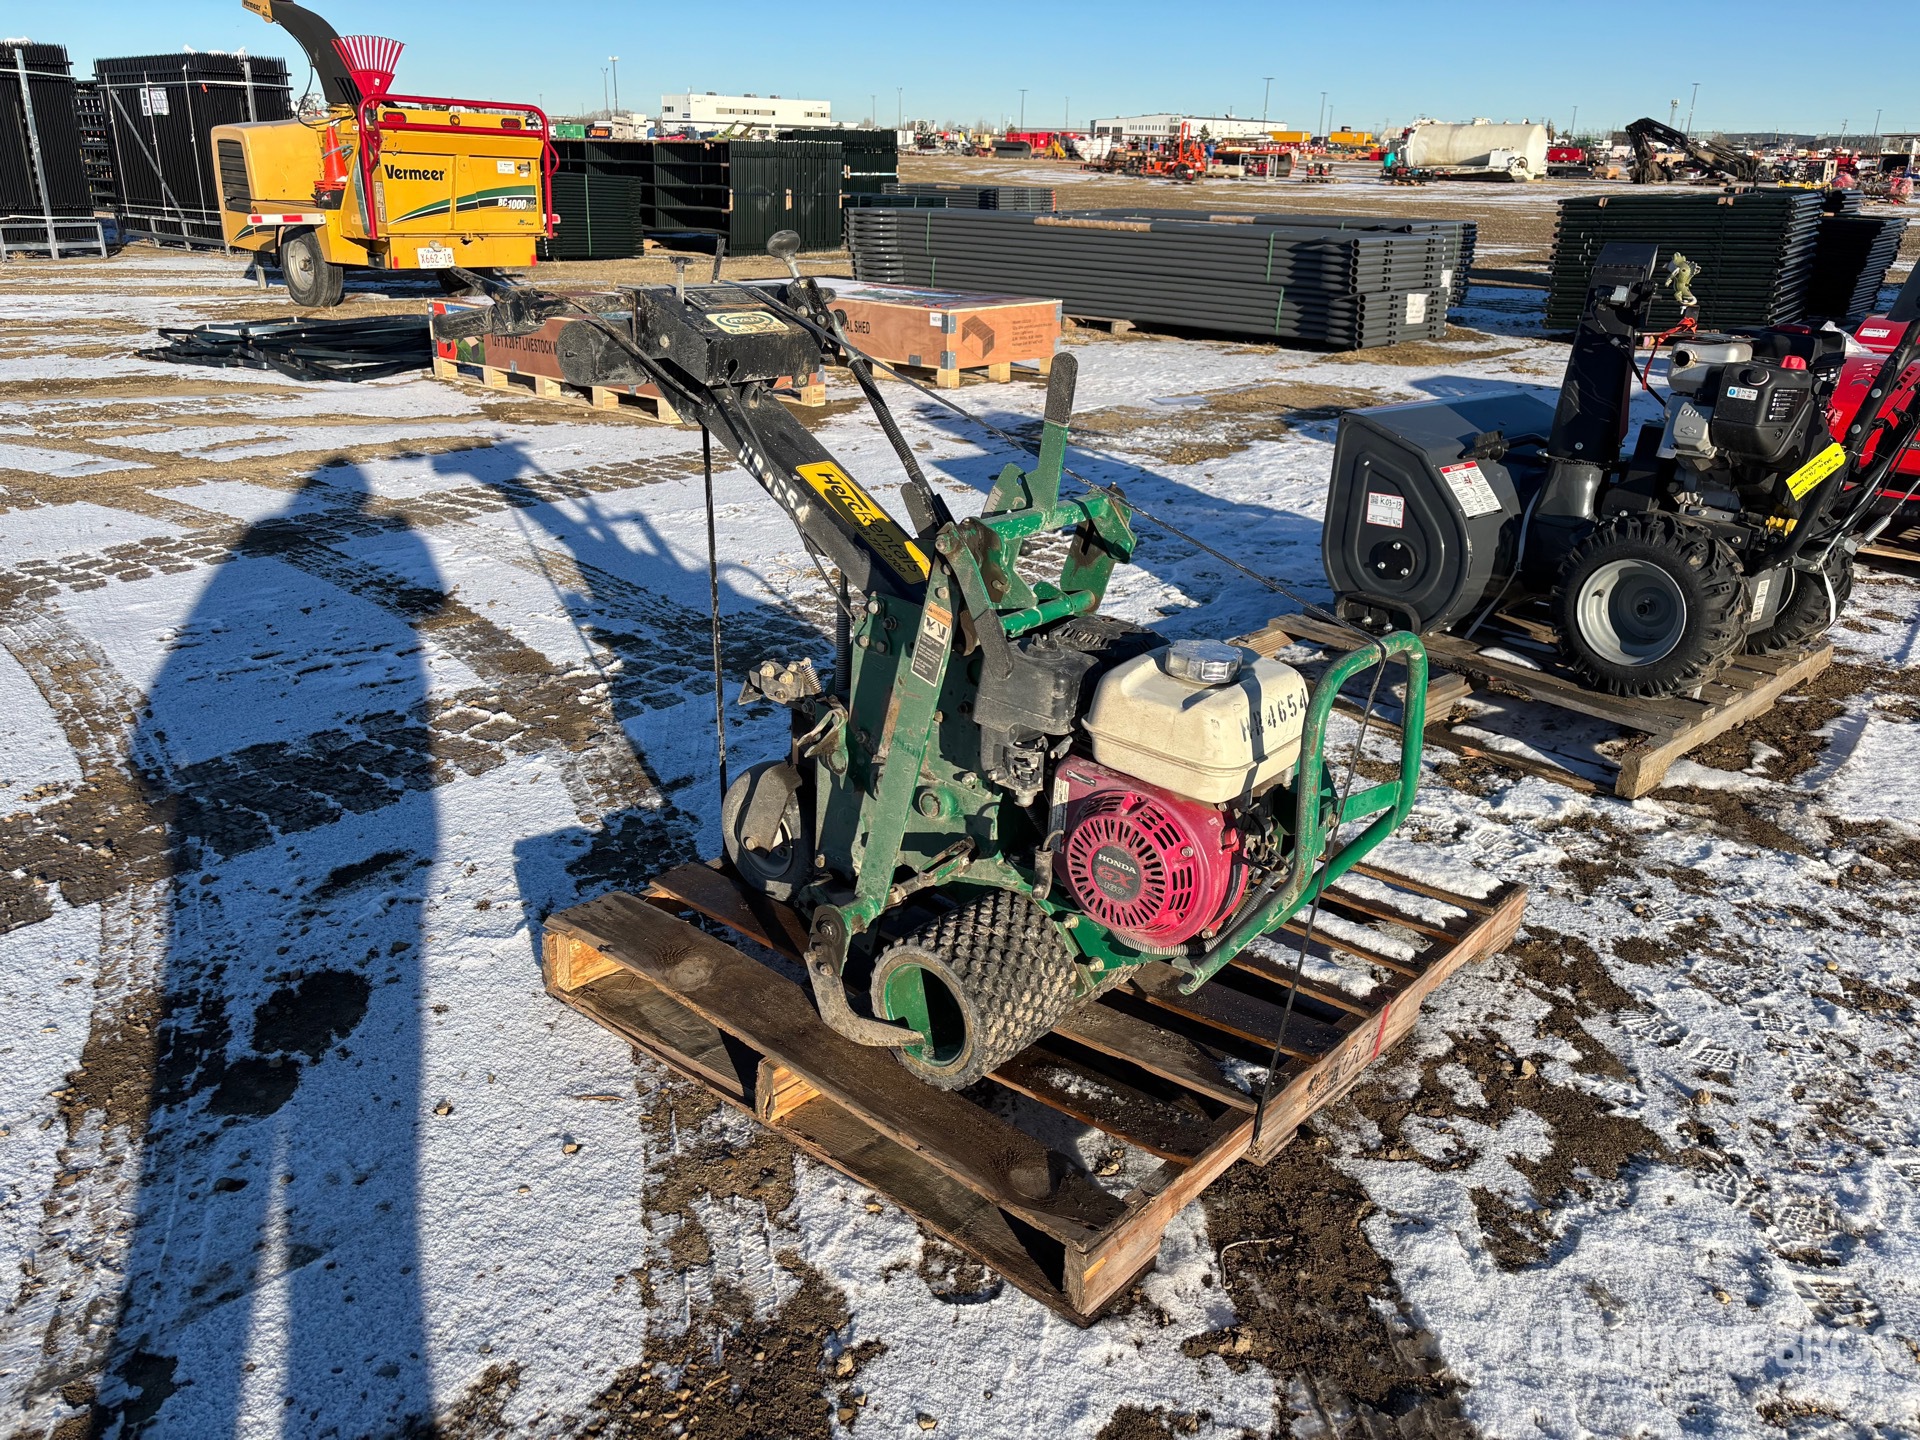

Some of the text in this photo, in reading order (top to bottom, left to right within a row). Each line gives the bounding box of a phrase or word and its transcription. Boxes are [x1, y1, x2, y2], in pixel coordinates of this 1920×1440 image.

[384, 164, 444, 180] Vermeer
[854, 320, 871, 334] SHED
[522, 337, 553, 354] LIVESTOCK
[853, 521, 907, 574] 888-777-2700
[1098, 853, 1137, 875] HONDA
